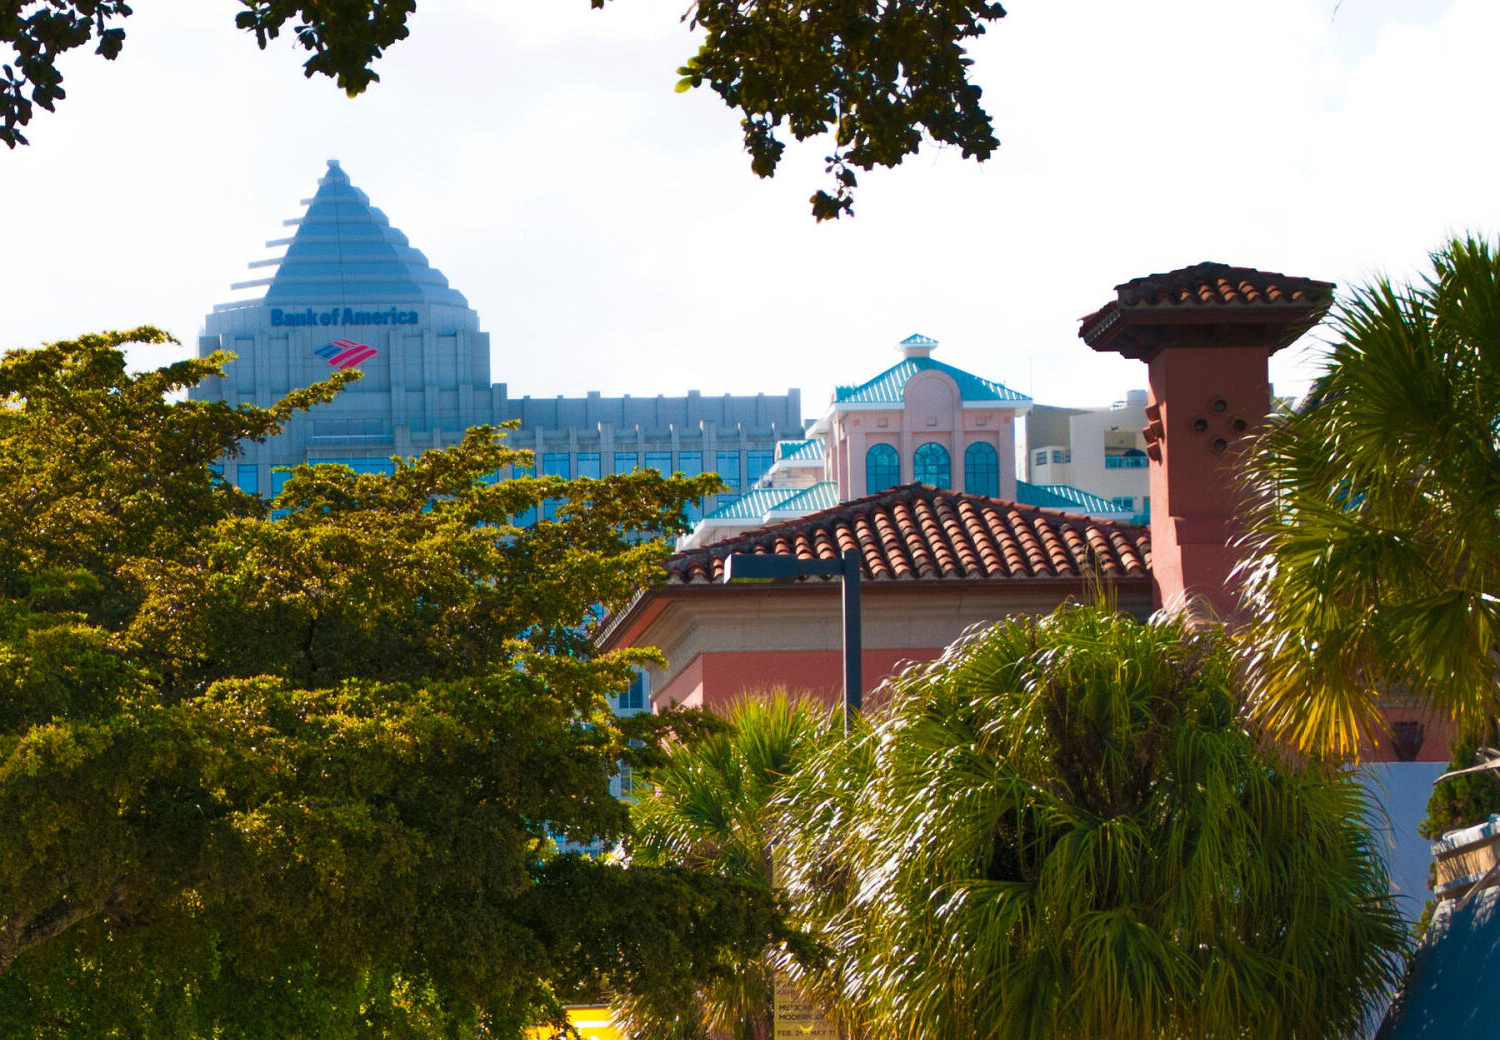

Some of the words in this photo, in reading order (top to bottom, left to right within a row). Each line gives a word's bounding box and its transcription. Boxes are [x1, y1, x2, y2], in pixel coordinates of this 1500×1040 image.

[270, 308, 318, 326] Bank
[319, 307, 340, 326] of
[341, 307, 419, 325] America
